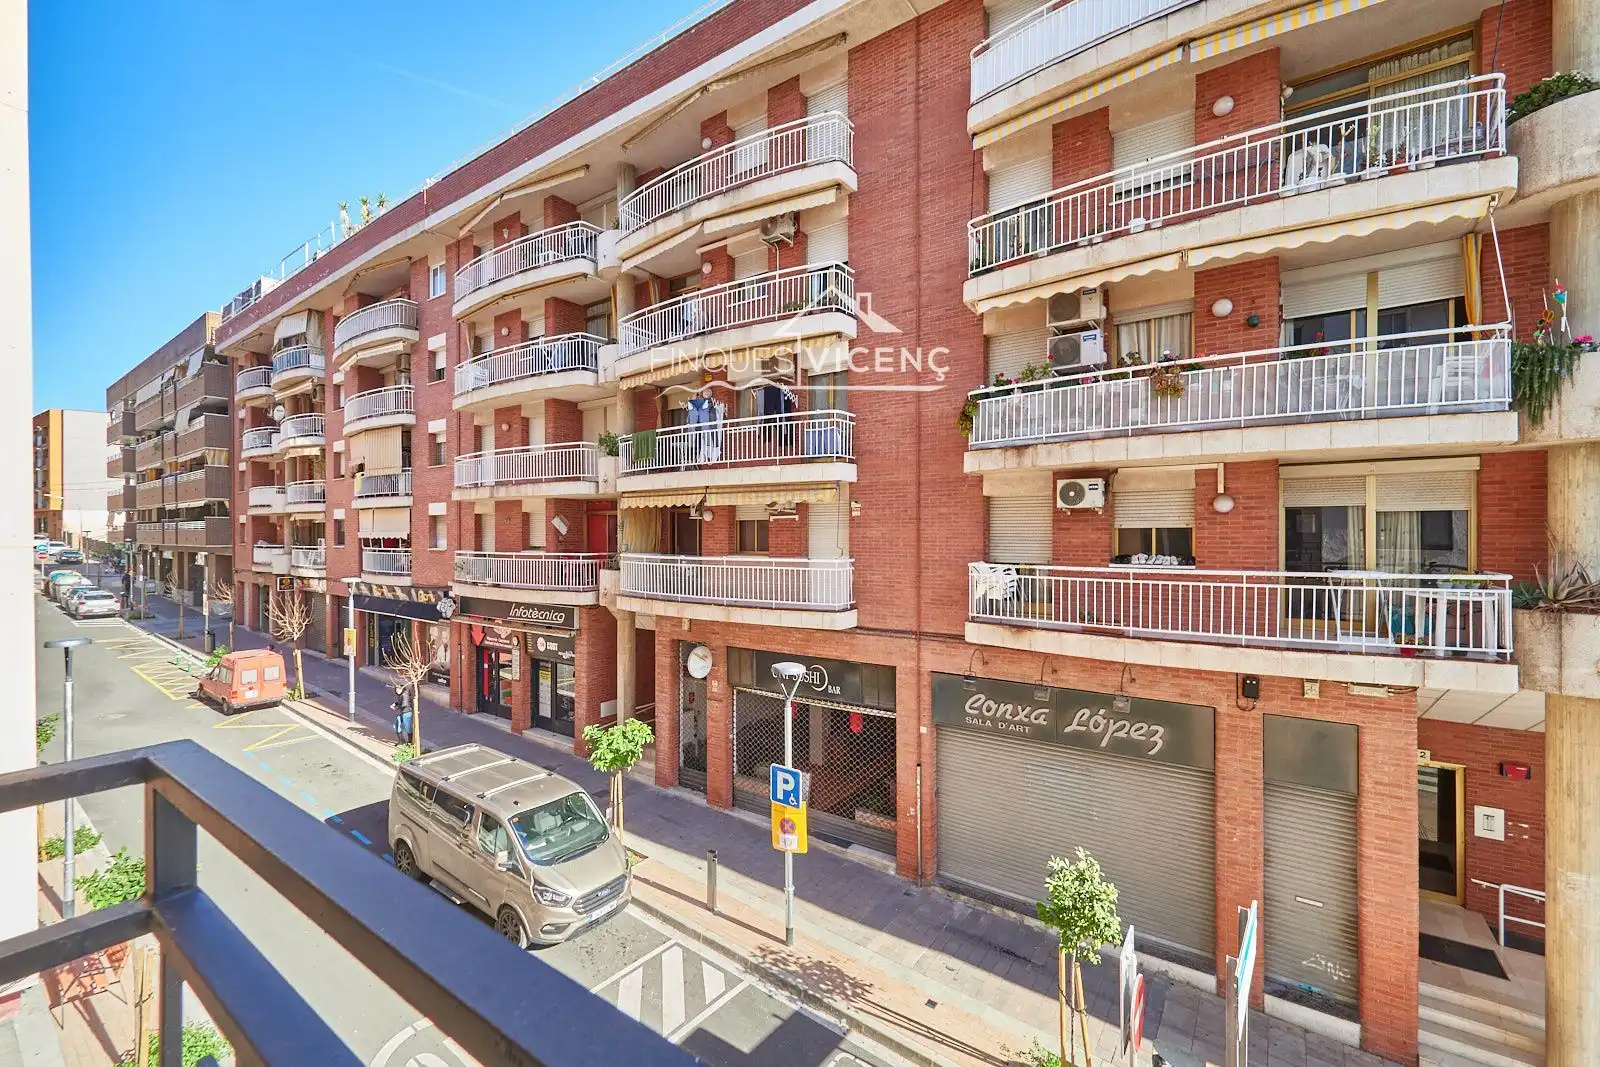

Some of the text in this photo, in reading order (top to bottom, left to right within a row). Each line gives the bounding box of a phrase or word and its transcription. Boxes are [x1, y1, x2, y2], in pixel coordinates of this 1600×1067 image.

[509, 602, 566, 624] Infotècnica
[827, 684, 841, 695] BAR
[964, 693, 1165, 756] Conxa López
[965, 716, 1031, 733] SALA D'ART
[1419, 751, 1426, 759] 2
[776, 770, 796, 800] P
